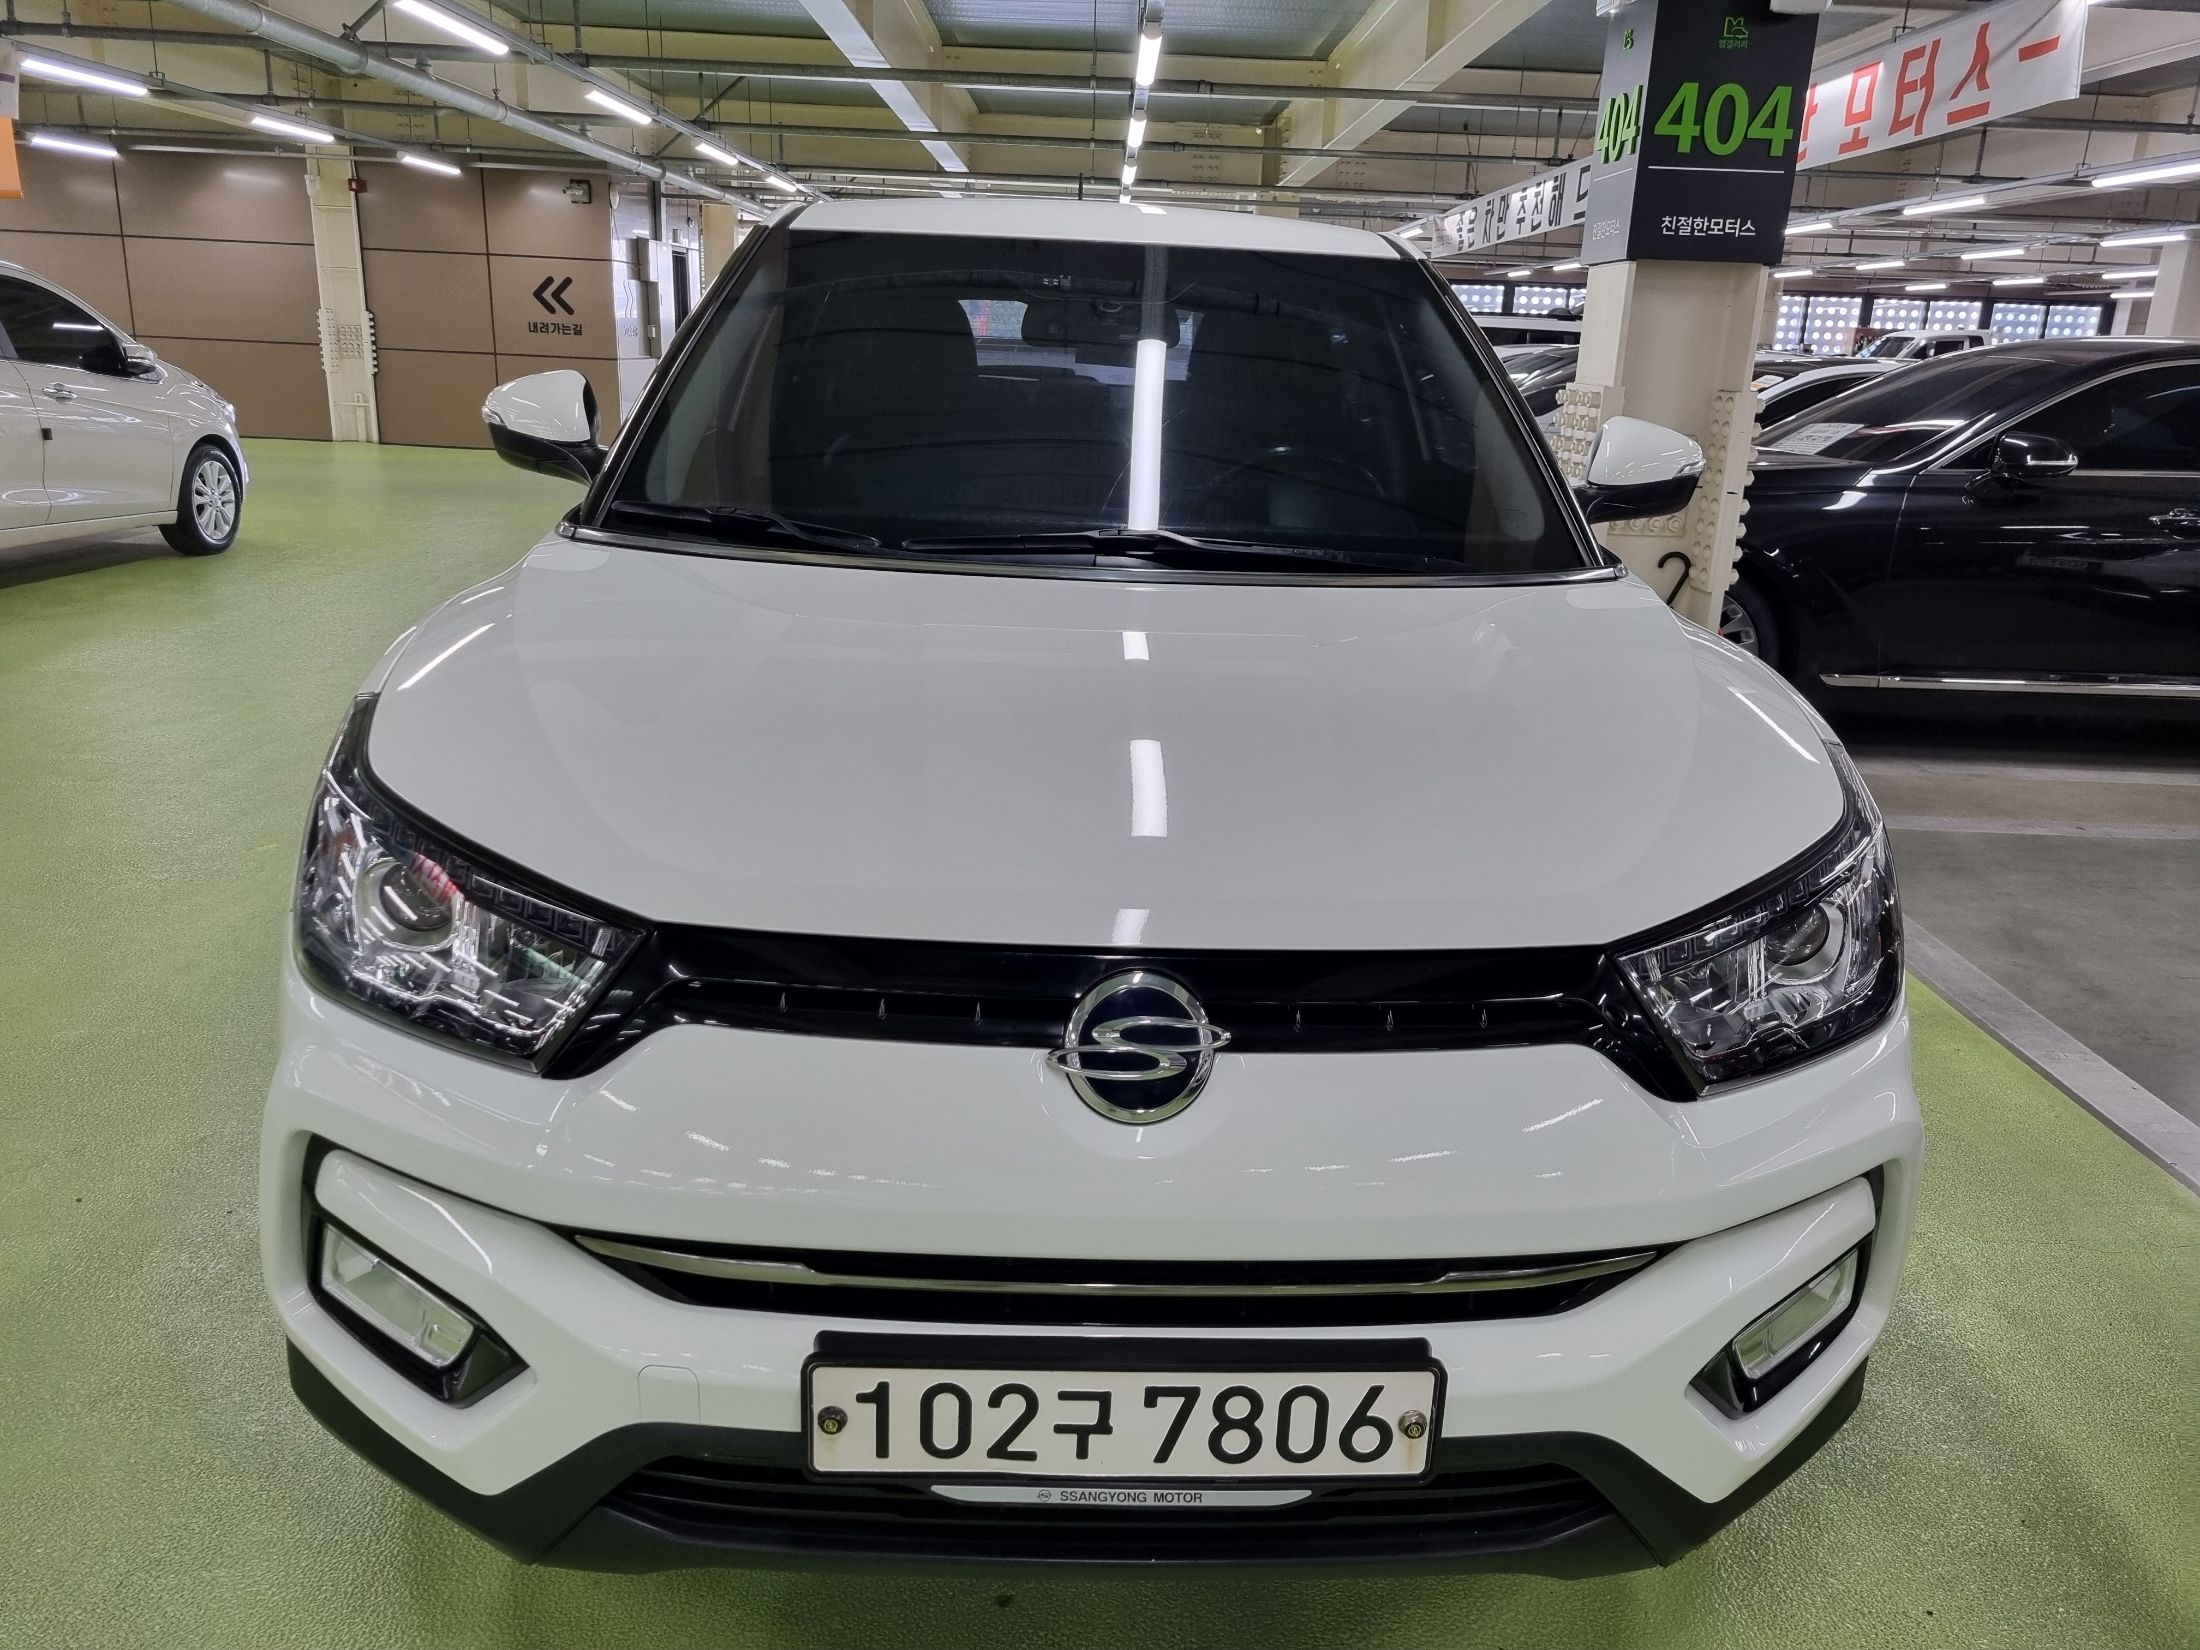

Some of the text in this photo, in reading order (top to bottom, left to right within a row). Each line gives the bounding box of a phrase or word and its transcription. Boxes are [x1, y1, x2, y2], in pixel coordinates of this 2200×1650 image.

[1594, 84, 1642, 164] 404
[1653, 81, 1794, 158] 404
[1455, 206, 1478, 252] 좋은
[1482, 192, 1510, 245] 차만
[1515, 171, 1567, 235] 추천해
[1660, 215, 1757, 238] 친절한모터스
[528, 321, 583, 336] 내려가는길
[855, 1380, 1395, 1464] 102구 7806
[1059, 1489, 1203, 1505] SSANGYONG MOTOR
